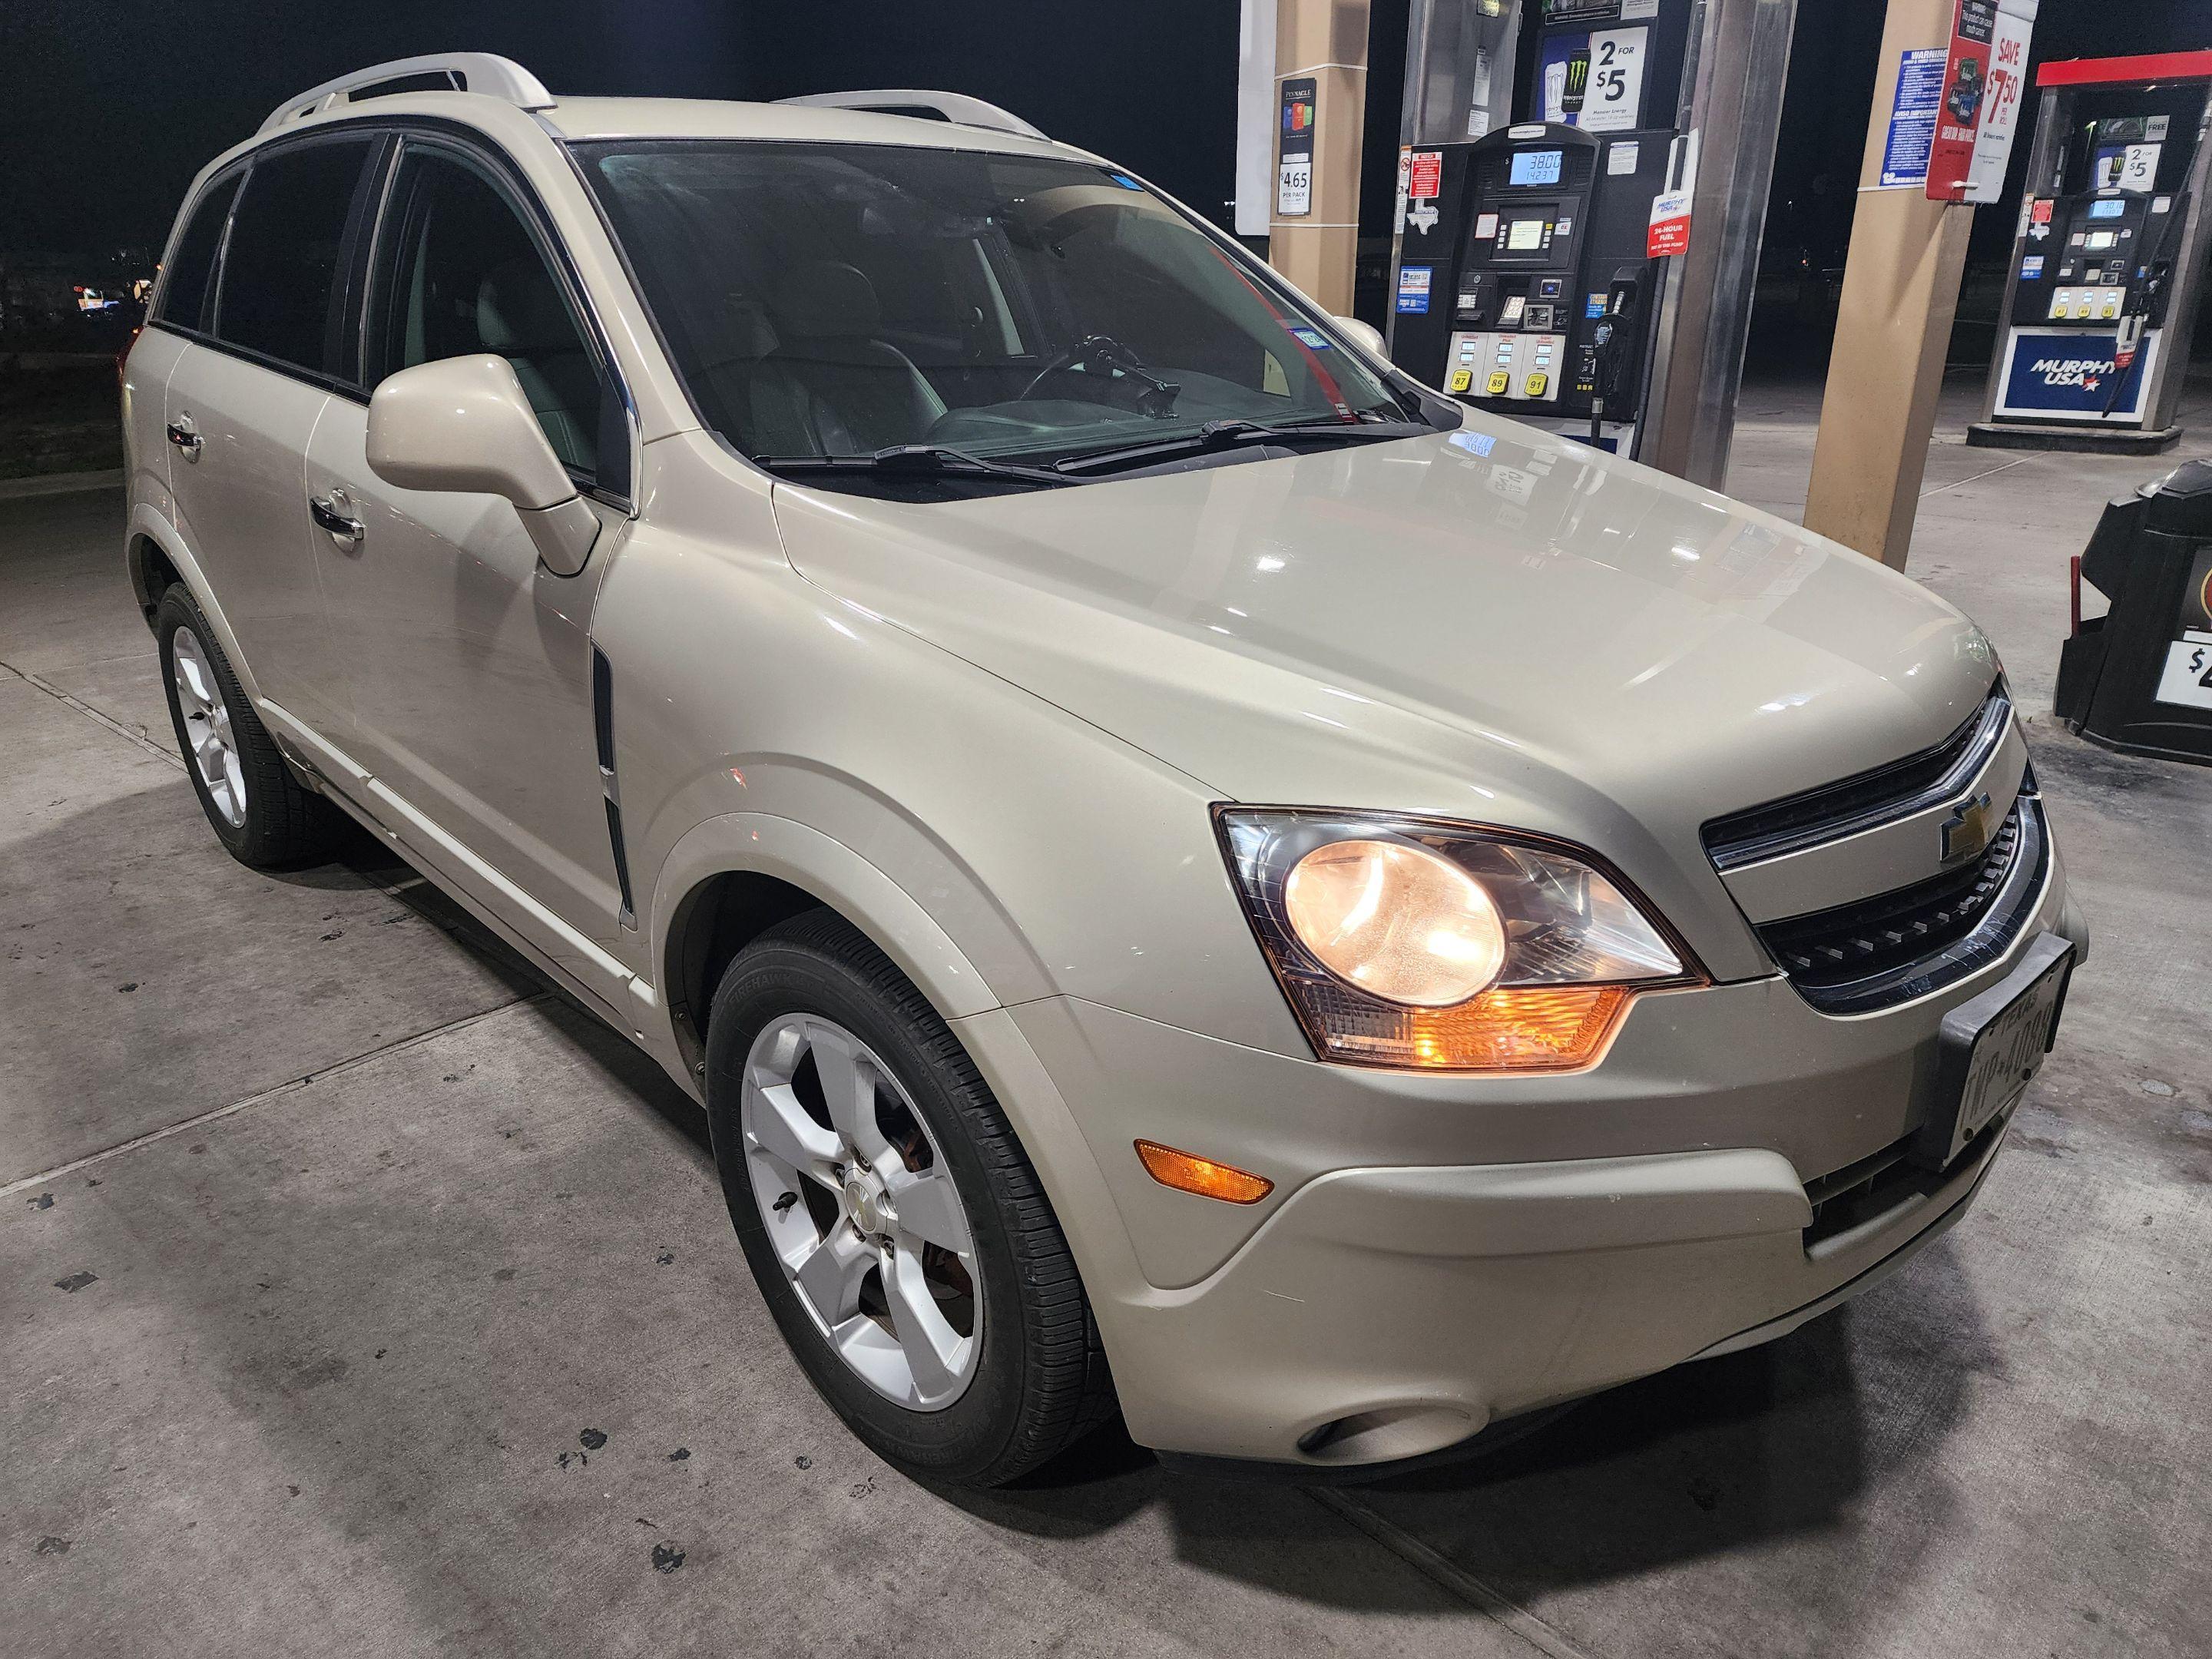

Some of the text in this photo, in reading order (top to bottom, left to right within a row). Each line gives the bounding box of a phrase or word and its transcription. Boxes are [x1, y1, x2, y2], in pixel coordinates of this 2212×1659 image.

[1598, 41, 1635, 66] 2 FOR
[1911, 49, 1948, 60] WARNING
[1998, 38, 2020, 65] SAVE
[1596, 68, 1627, 101] $5
[1286, 89, 1311, 98] PINNACLE
[2132, 149, 2141, 160] 2
[1505, 157, 1510, 165] $
[2130, 162, 2147, 177] $5
[1280, 172, 1307, 188] $4.65
[1654, 225, 1683, 234] 24-HOUR
[2030, 359, 2116, 374] MURPHY
[1455, 377, 1466, 386] 87
[1492, 379, 1503, 387] 89
[1529, 380, 1541, 389] 91
[2044, 373, 2085, 386] USA
[1999, 986, 2039, 1037] TEXAS
